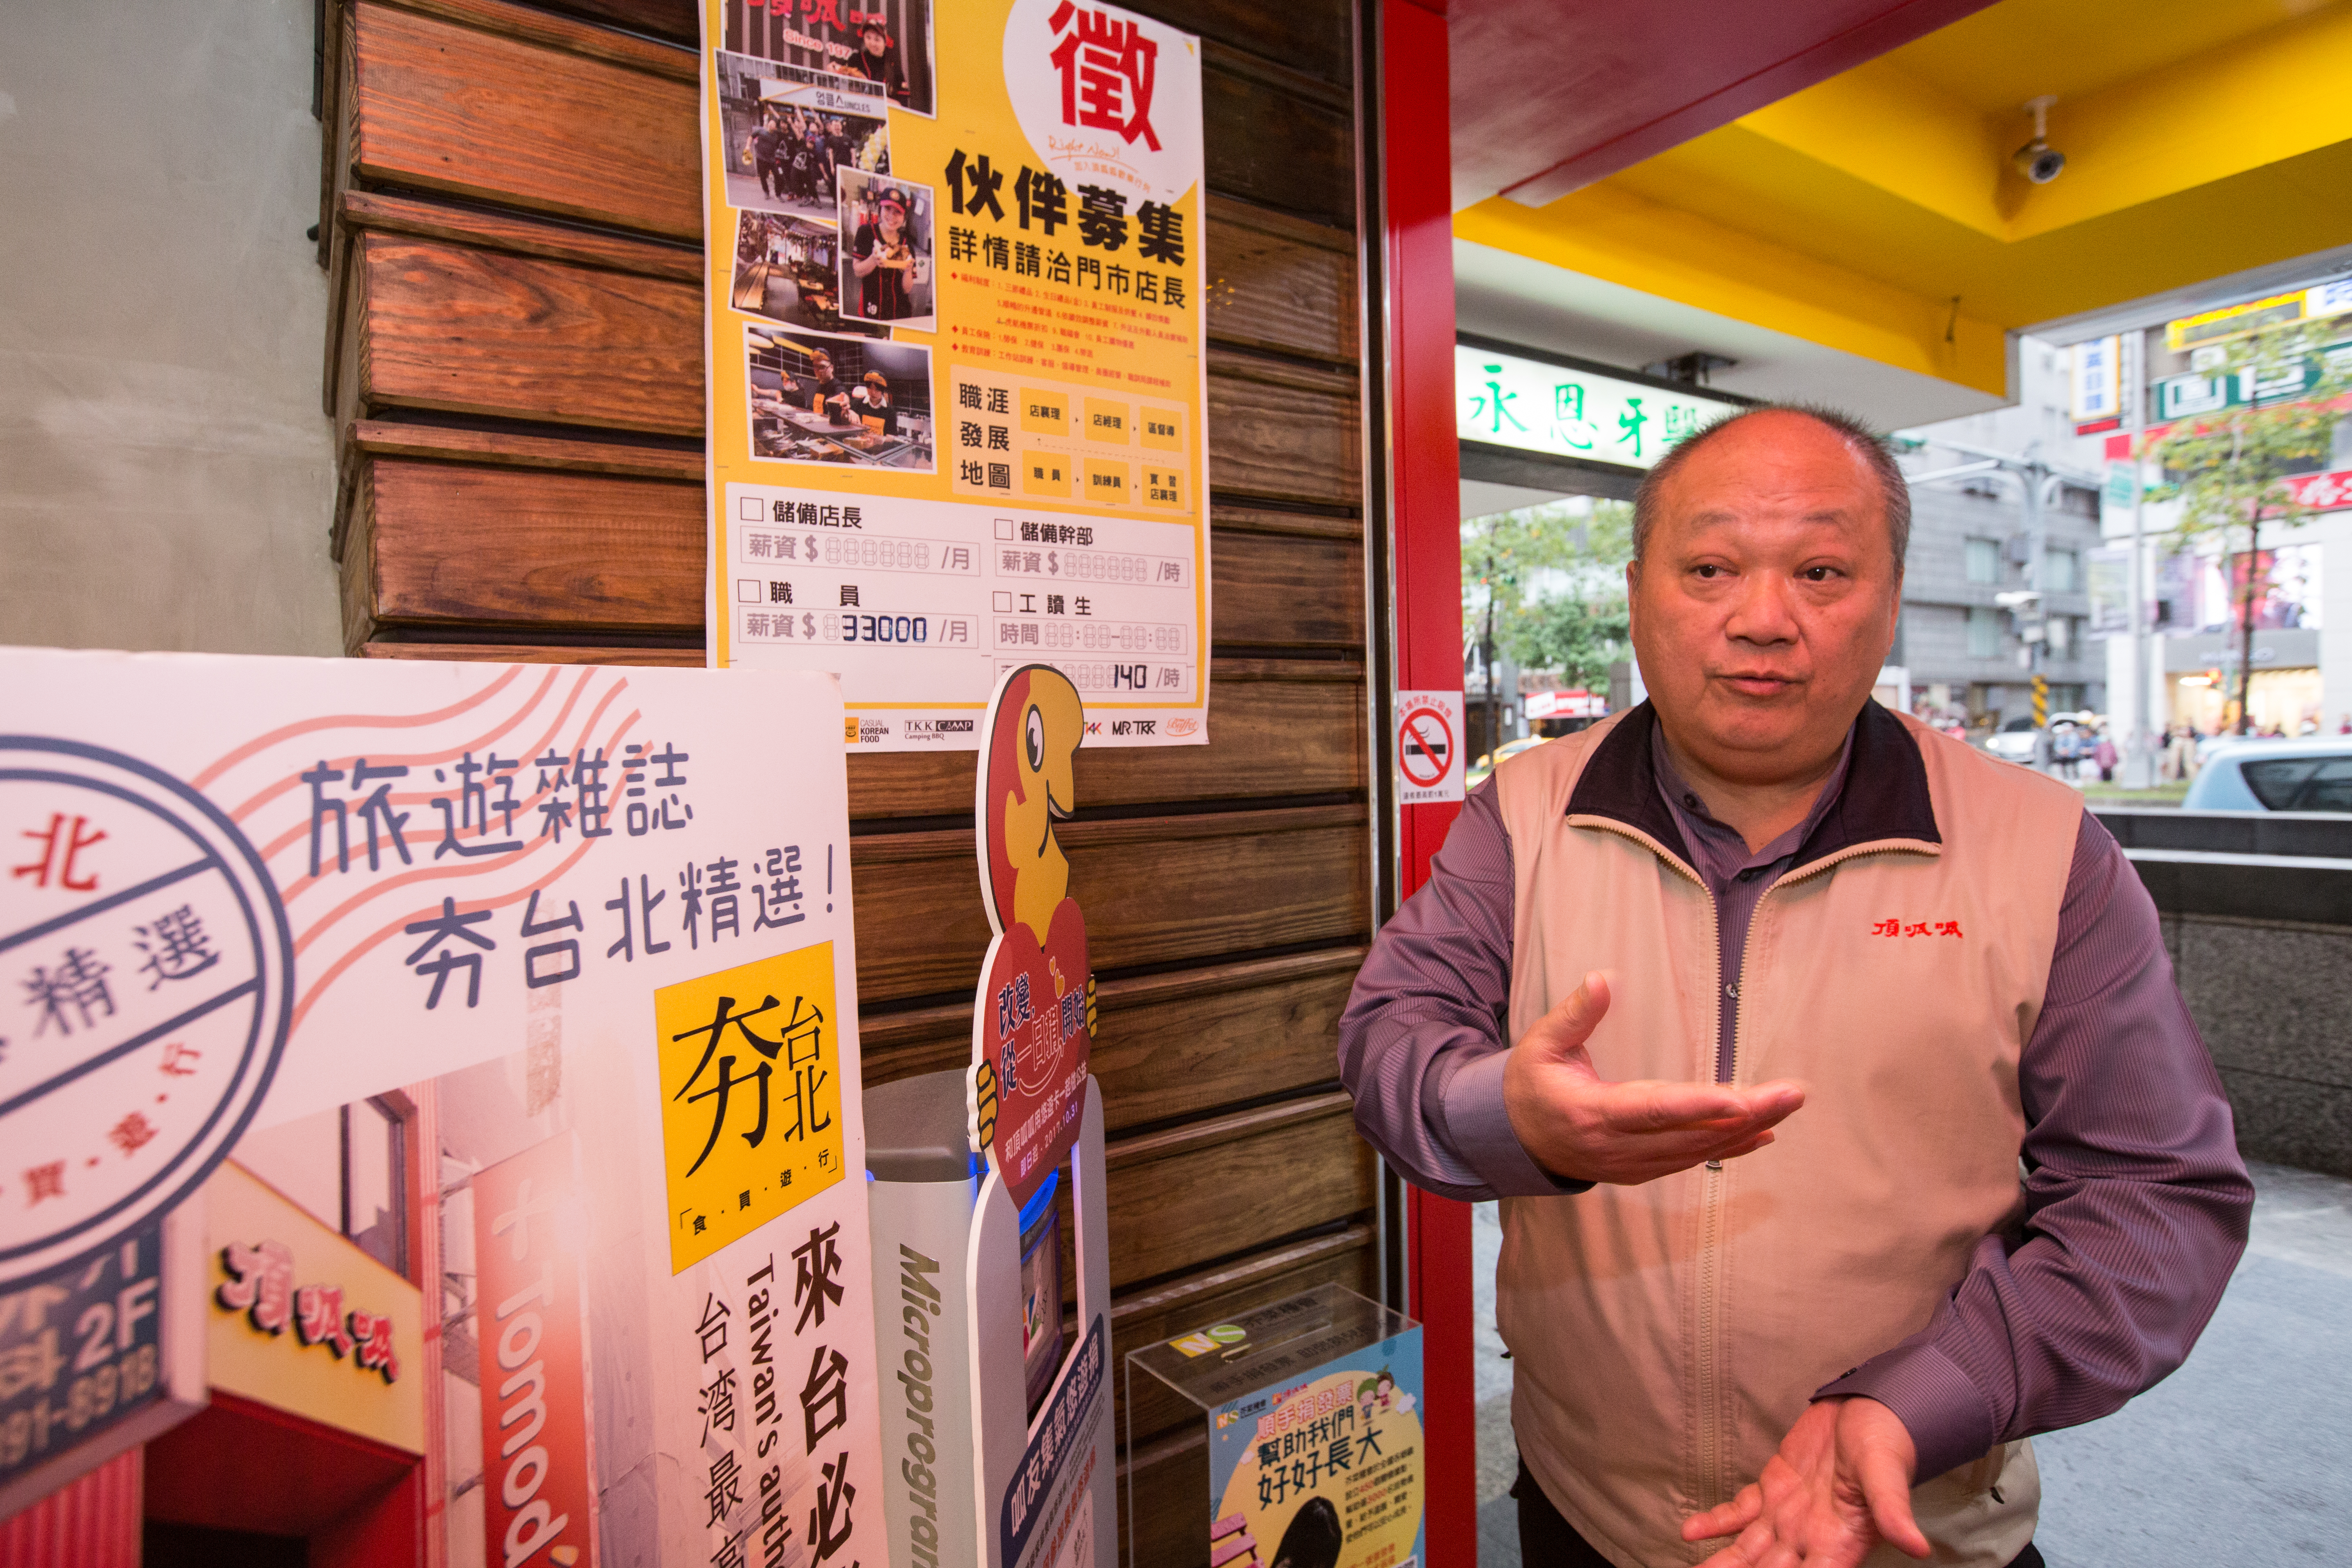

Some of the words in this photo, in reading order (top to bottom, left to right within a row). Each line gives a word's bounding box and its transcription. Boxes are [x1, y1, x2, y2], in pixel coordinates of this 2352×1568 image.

[825, 42, 858, 60] 197
[1048, 0, 1162, 152] 徵
[944, 148, 1185, 267] 伙伴募集
[949, 226, 1186, 309] 詳情請洽門市店長
[960, 383, 1010, 415] 職涯
[960, 421, 1010, 451] 發展
[960, 460, 1011, 490] 地圖
[773, 501, 862, 529] 儲備店長
[1020, 521, 1093, 546] 儲備幹部
[1000, 623, 1039, 646] 時間
[860, 719, 884, 727] CASUAL
[860, 735, 880, 743] FOOD
[904, 733, 931, 741] Camping
[937, 721, 972, 731] CAMP
[300, 742, 693, 878] 旅遊雜誌
[747, 1253, 783, 1459] Taiwan's
[791, 1220, 860, 1568] 來台必
[1257, 1380, 1354, 1442] 順手捐發票
[1258, 1405, 1355, 1470] 幫助我們
[1257, 1427, 1383, 1511] 好好長大
[760, 1464, 793, 1568] auth
